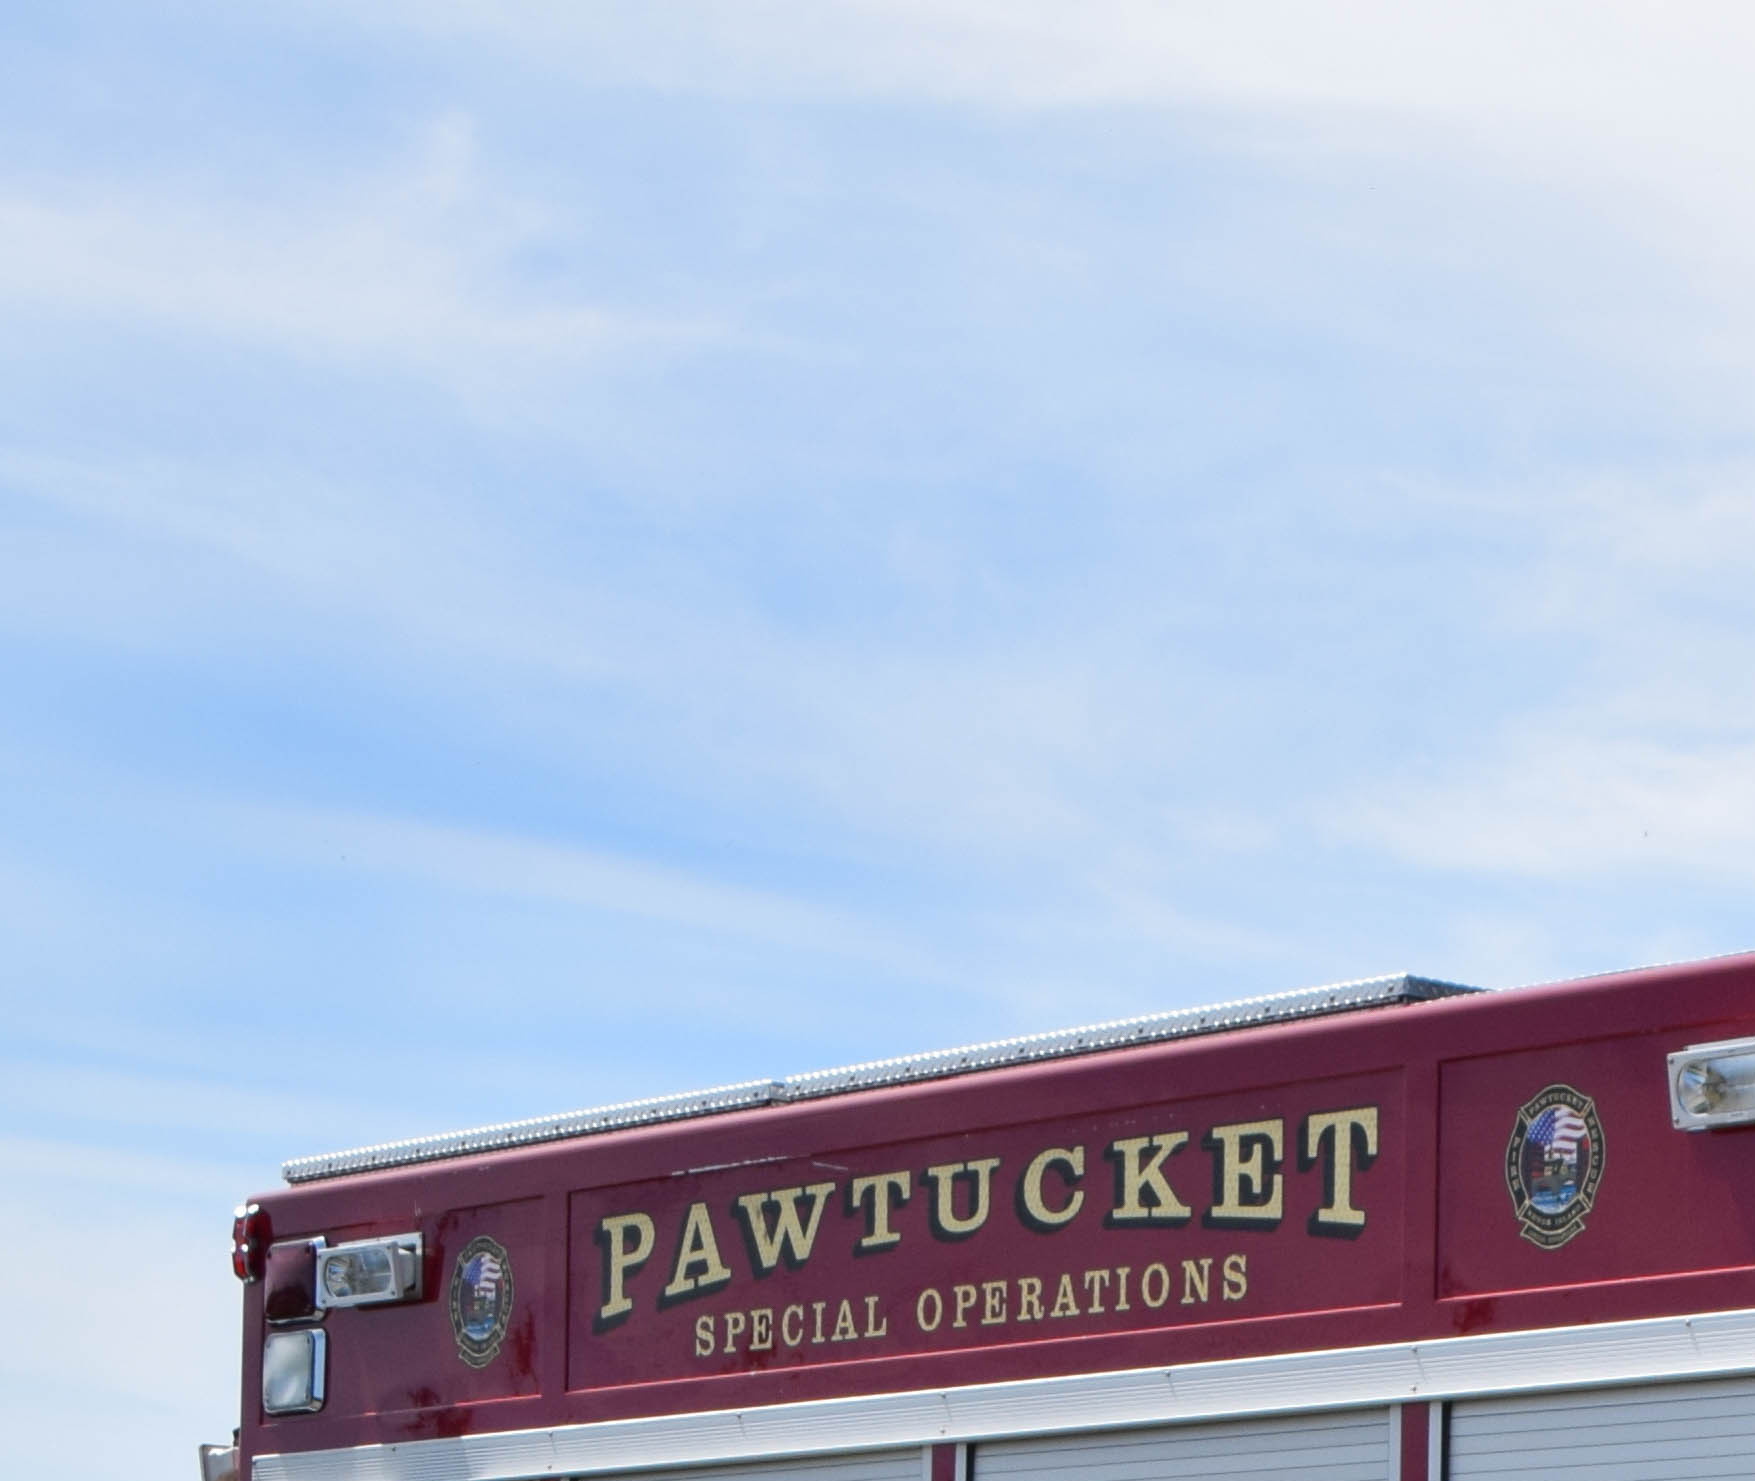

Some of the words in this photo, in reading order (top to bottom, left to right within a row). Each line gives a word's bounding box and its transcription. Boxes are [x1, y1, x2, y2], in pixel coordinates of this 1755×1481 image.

[594, 1107, 1380, 1332] PAWTUCKET
[694, 1295, 887, 1358] SPECIAL
[915, 1254, 1249, 1334] OPERATIONS
